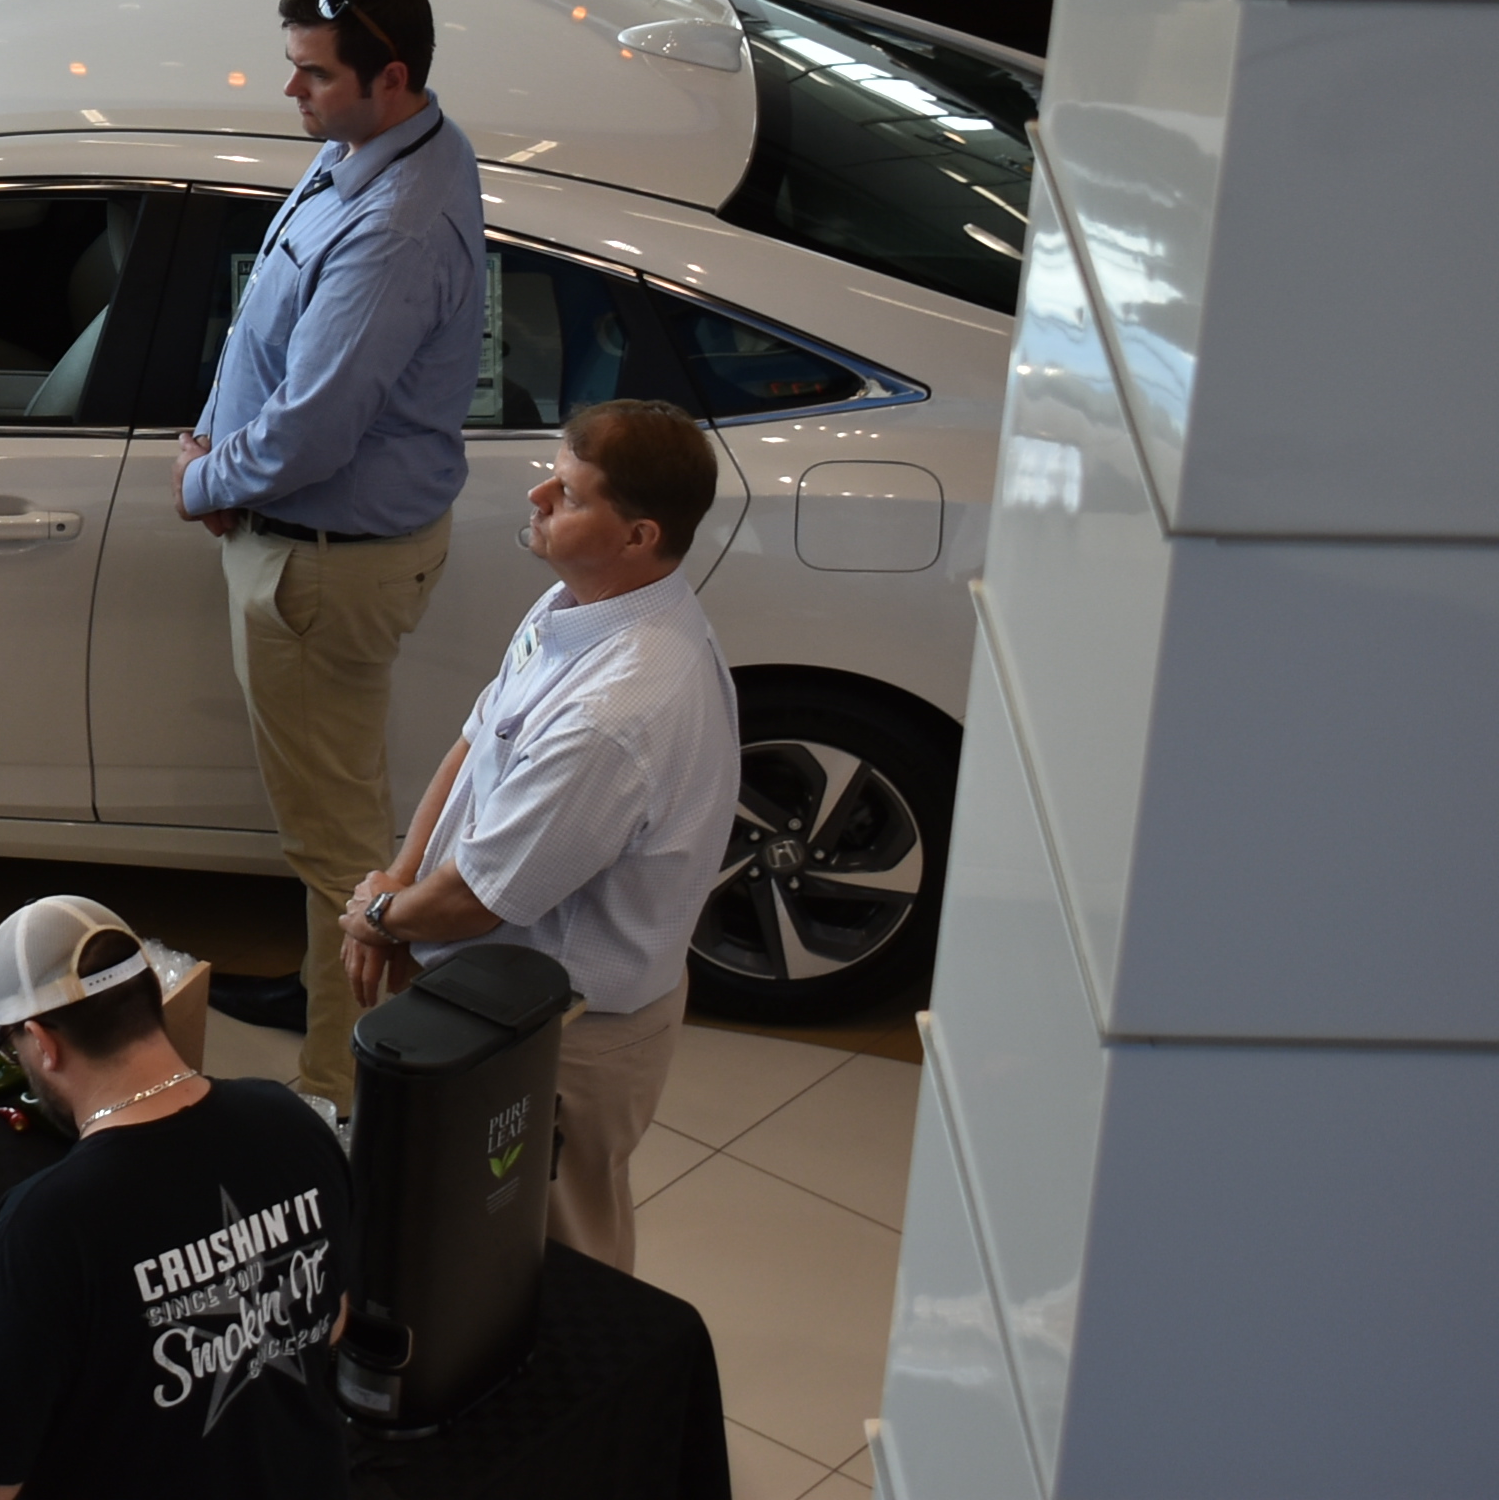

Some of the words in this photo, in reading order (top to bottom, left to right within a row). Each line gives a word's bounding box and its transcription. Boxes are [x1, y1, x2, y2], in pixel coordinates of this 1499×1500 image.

[487, 1114, 528, 1154] LEAF
[489, 1093, 531, 1135] PURE
[134, 1200, 290, 1302] CRUSHIN'
[294, 1188, 322, 1235] IT
[290, 1238, 329, 1314] It
[146, 1283, 221, 1327] SINCE
